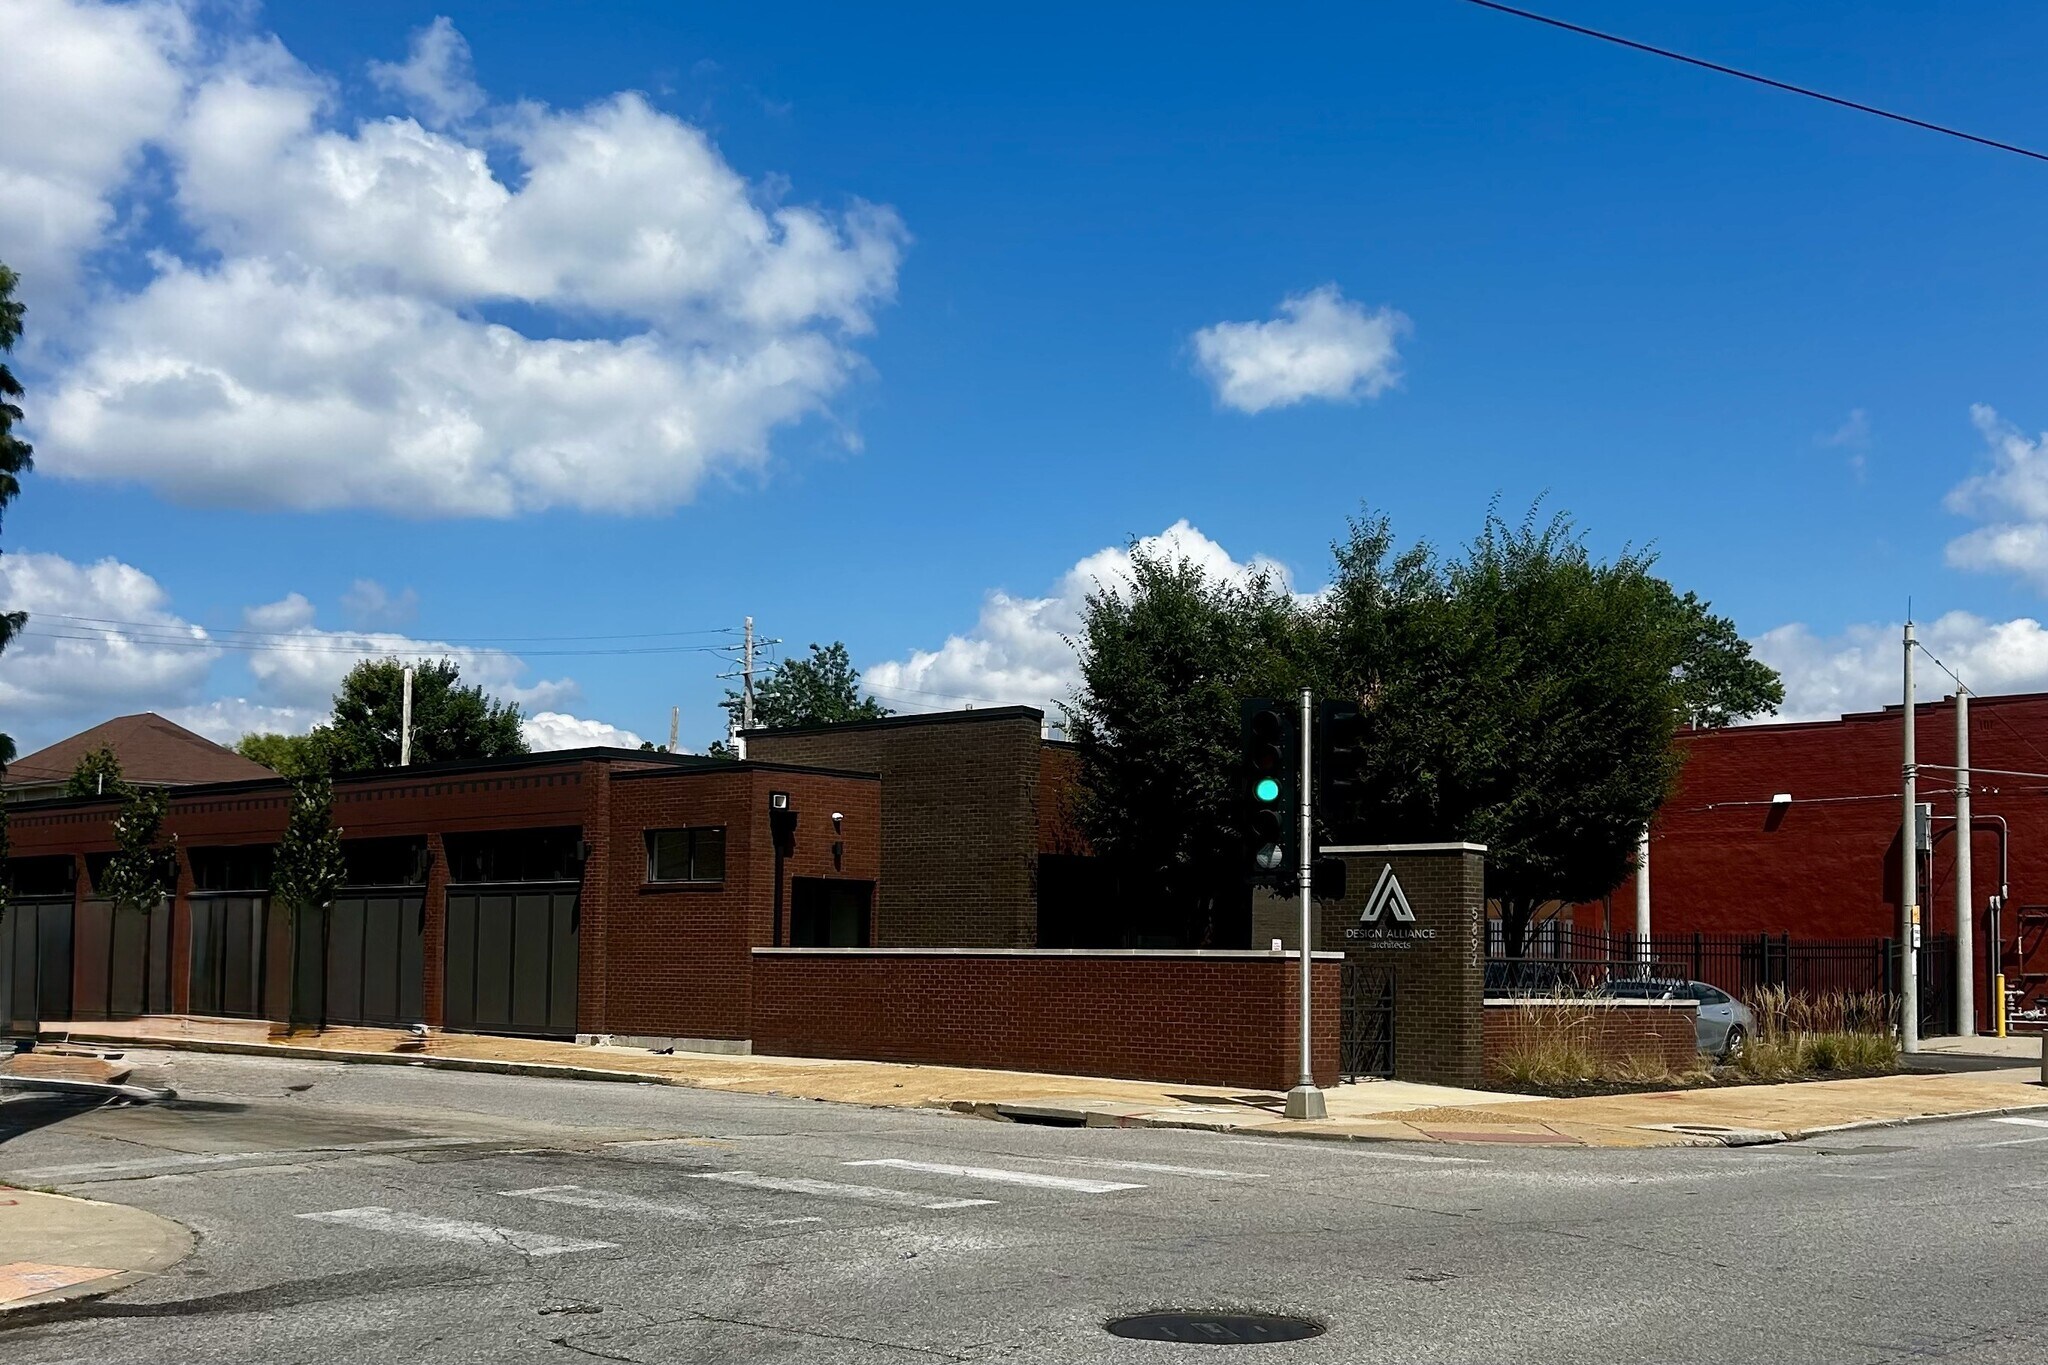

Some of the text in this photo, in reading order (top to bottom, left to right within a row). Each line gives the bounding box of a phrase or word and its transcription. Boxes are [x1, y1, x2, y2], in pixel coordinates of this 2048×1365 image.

[1346, 929, 1436, 938] DESIGN ALLIANCE
[1371, 941, 1411, 949] architects
